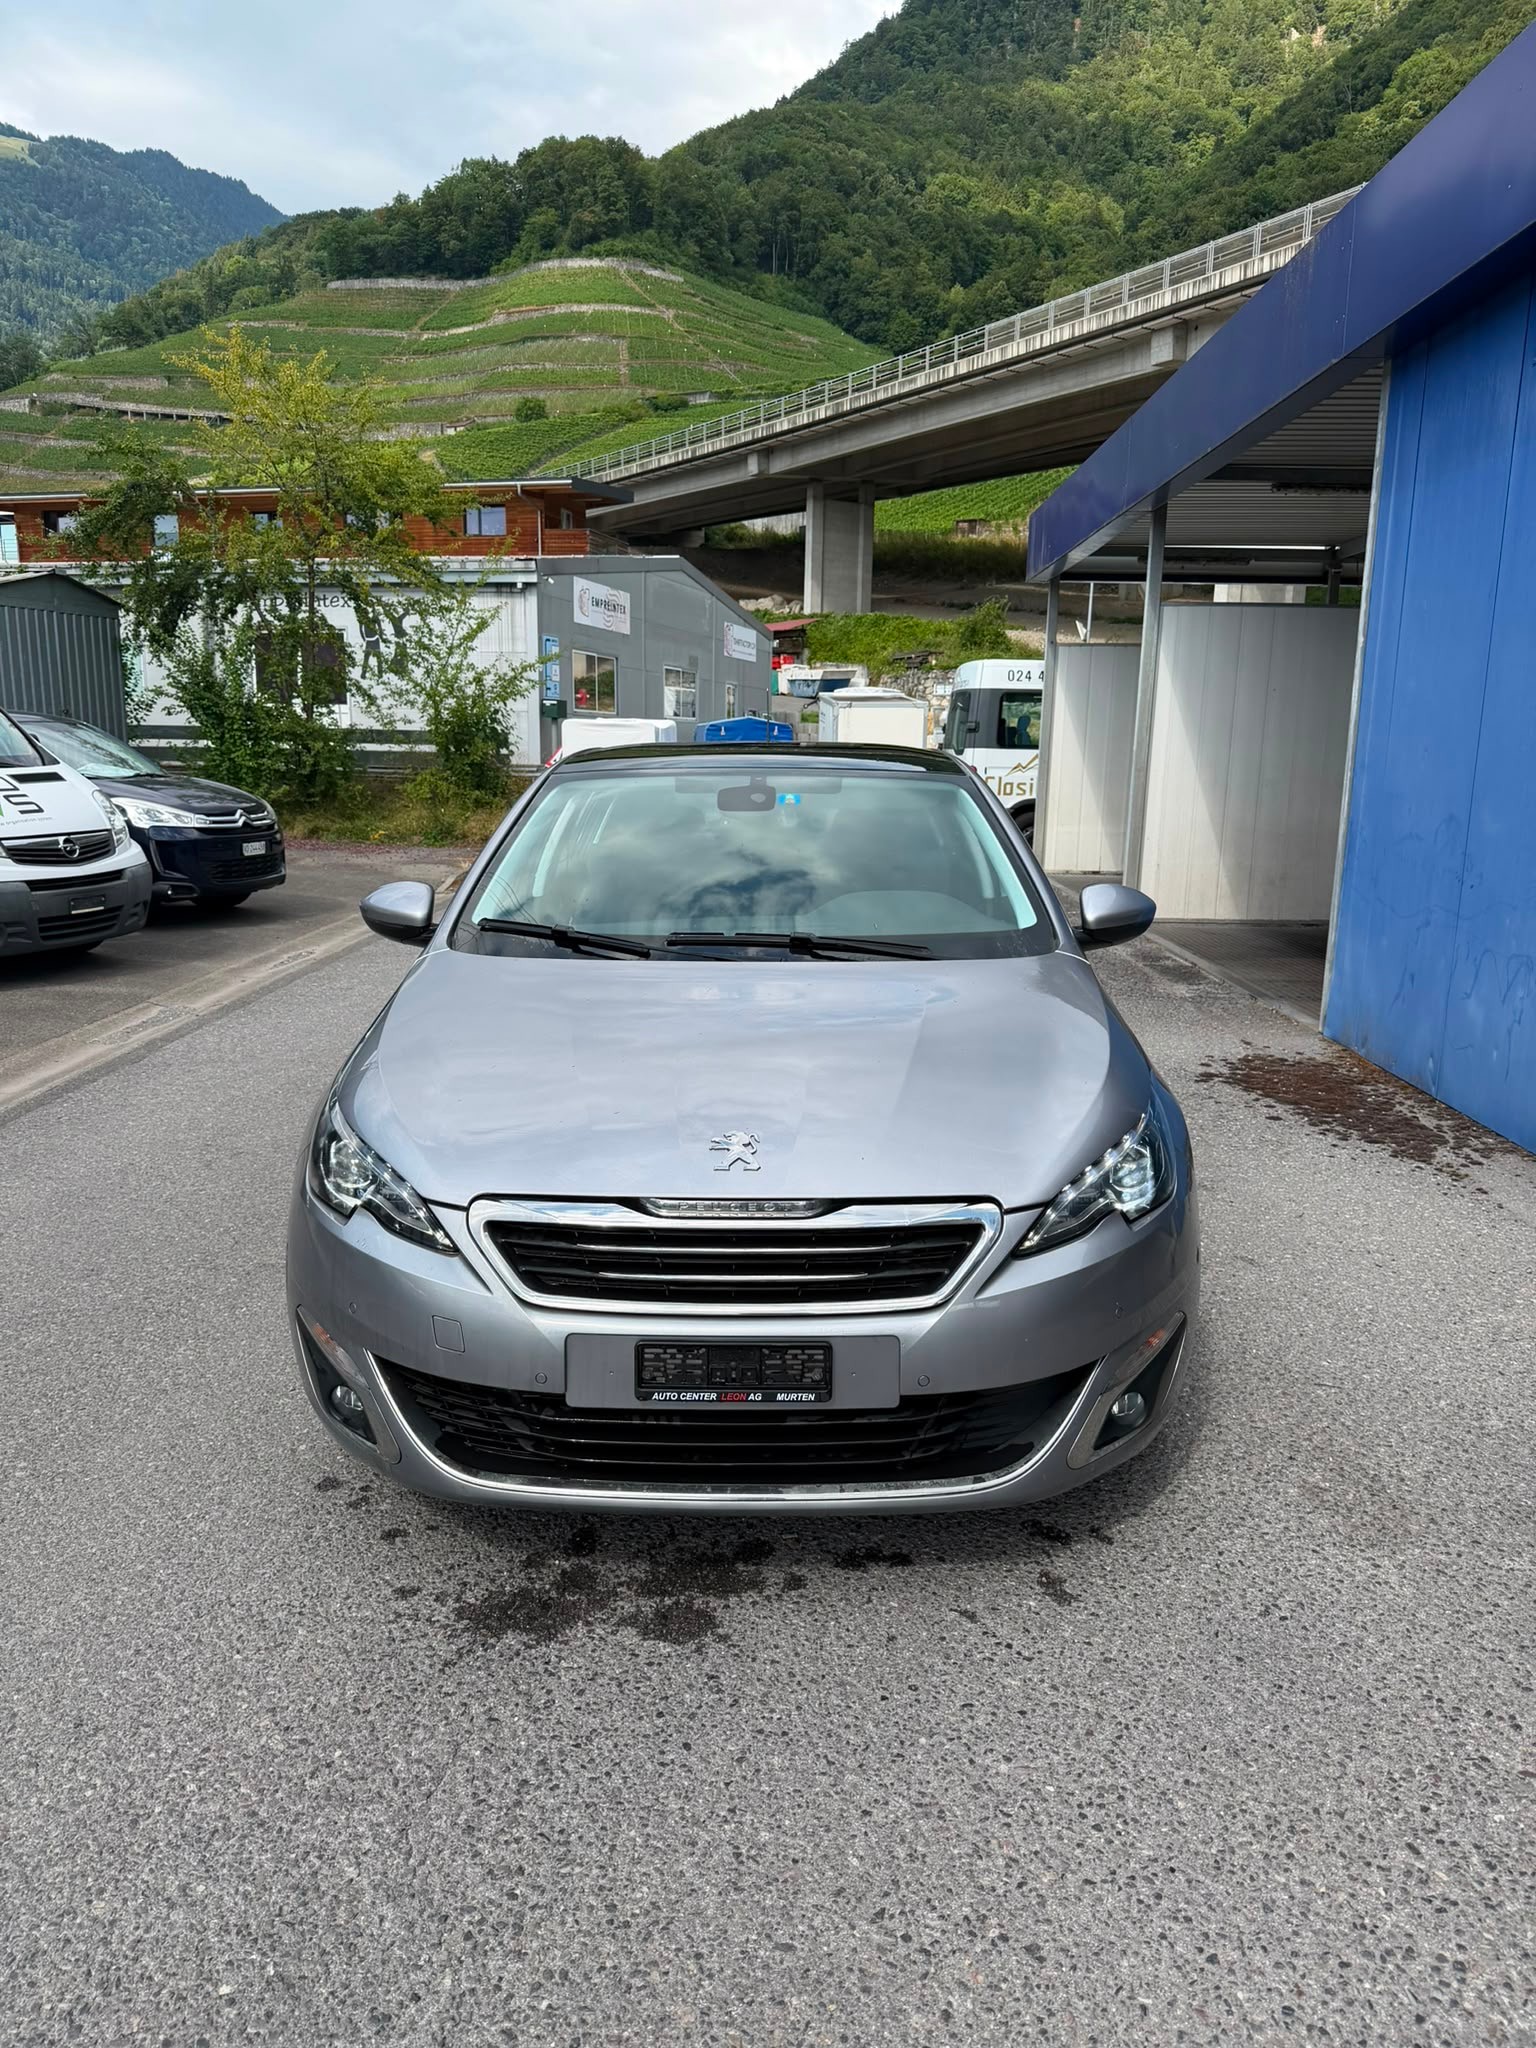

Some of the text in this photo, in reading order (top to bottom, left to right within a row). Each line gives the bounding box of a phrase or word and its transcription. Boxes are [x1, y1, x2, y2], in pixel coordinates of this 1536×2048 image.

[1007, 669, 1032, 682] 024
[678, 1201, 793, 1212] PEUGEOT
[652, 1392, 816, 1401] AUTO CENTER LEON AG MURTEN
